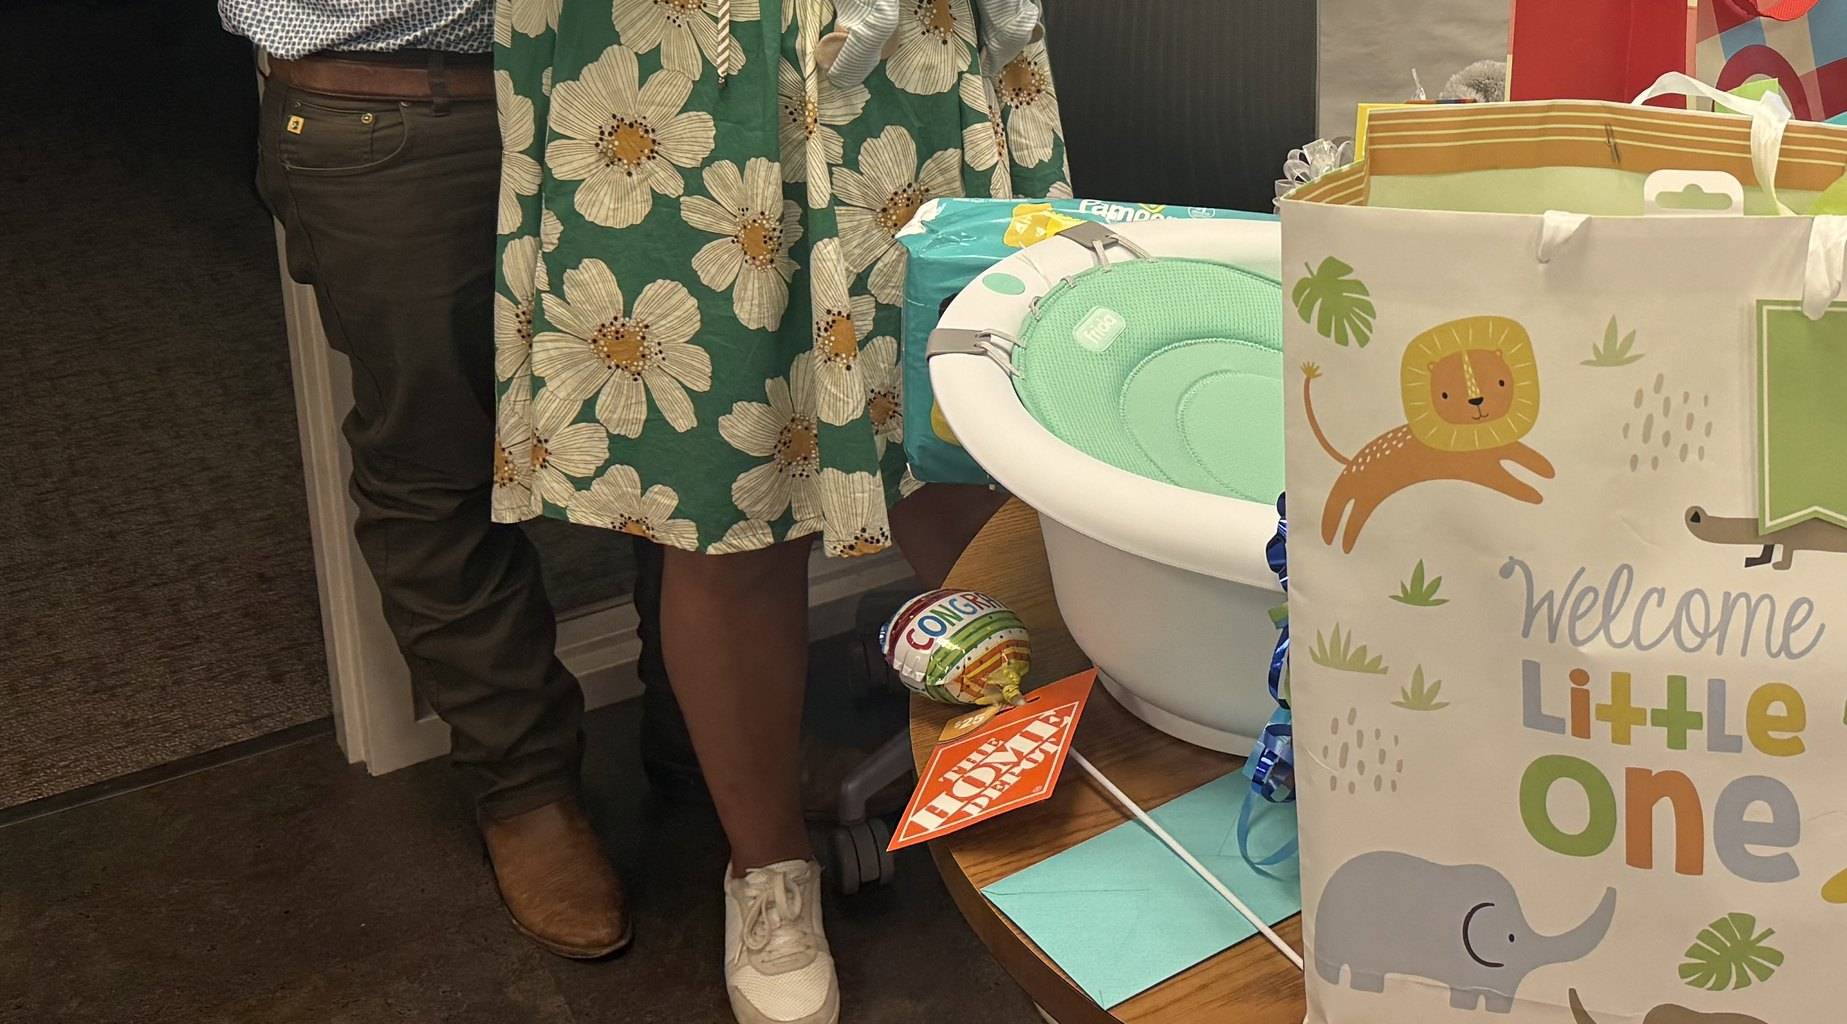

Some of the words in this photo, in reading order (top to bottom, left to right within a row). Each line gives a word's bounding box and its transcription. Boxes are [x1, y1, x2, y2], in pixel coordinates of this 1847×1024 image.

[1084, 316, 1118, 344] frida
[1499, 556, 1826, 660] Welcome
[909, 709, 1071, 833] HOME
[938, 737, 1004, 784] THE
[960, 737, 1062, 817] DEPOT
